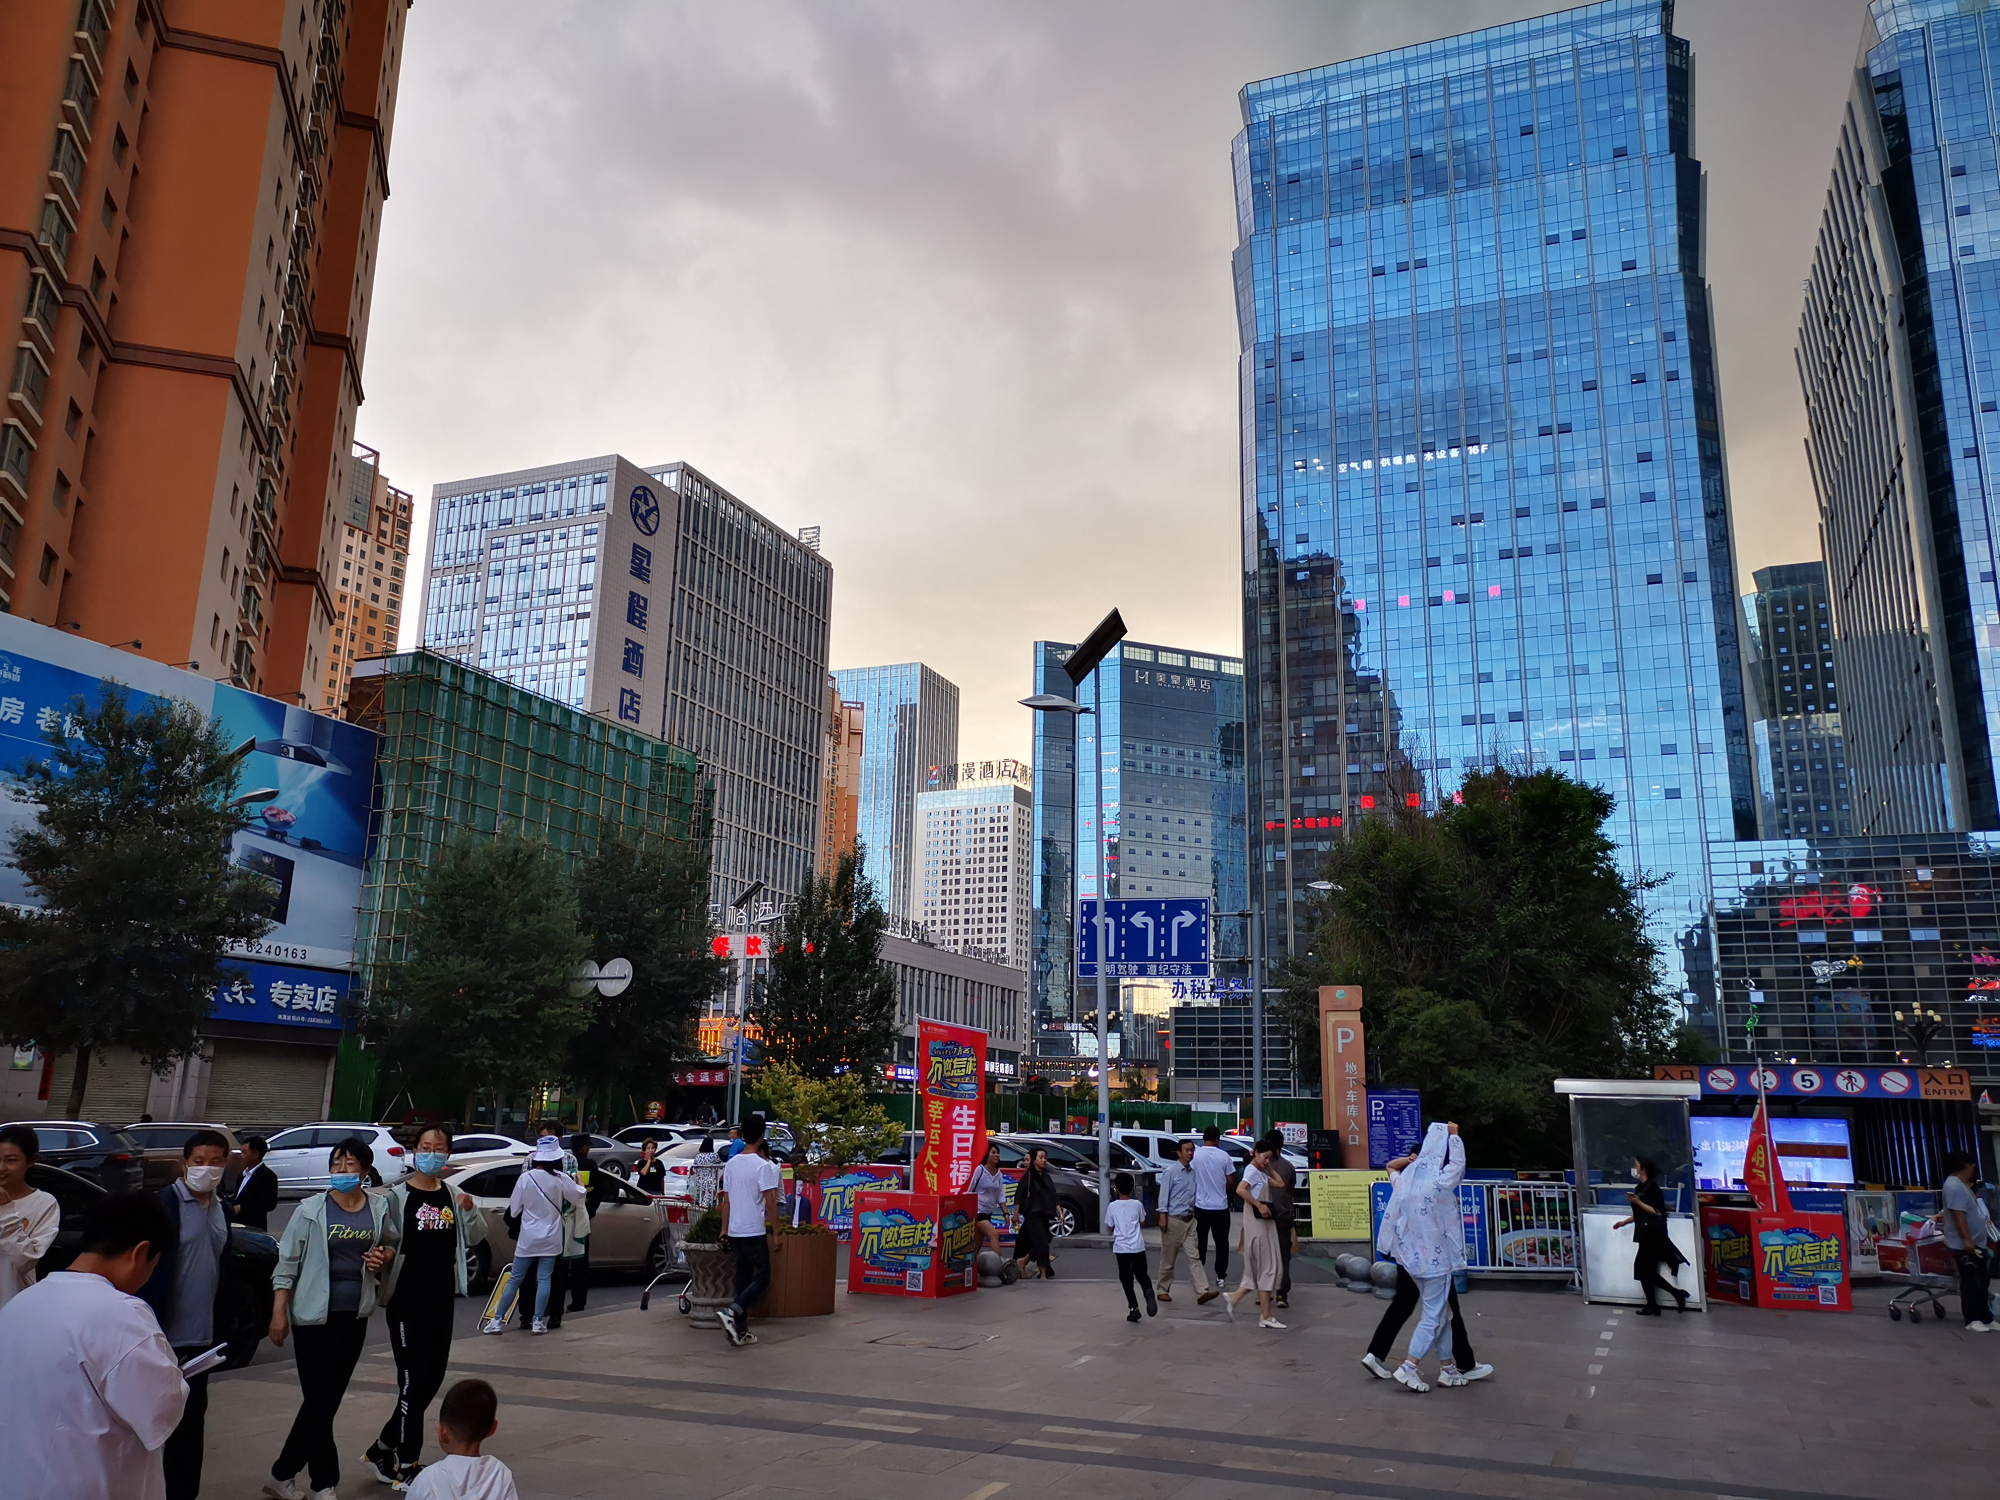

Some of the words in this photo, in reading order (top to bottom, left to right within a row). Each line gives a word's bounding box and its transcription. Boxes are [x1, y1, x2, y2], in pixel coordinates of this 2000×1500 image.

[1467, 444, 1488, 455] 16F
[619, 541, 651, 725] 星程酒店
[1147, 964, 1192, 976] 遵纪守法
[269, 980, 338, 1014] 专卖店
[1337, 1027, 1355, 1054] P
[1801, 1074, 1814, 1089] 5
[1923, 1072, 1964, 1086] 入口
[1925, 1088, 1965, 1096] ENTRY
[1344, 1061, 1360, 1146] 地下车库入口
[1372, 1100, 1385, 1116] P
[857, 1215, 933, 1260] 不燃怎样
[1763, 1234, 1840, 1277] 不燃怎样
